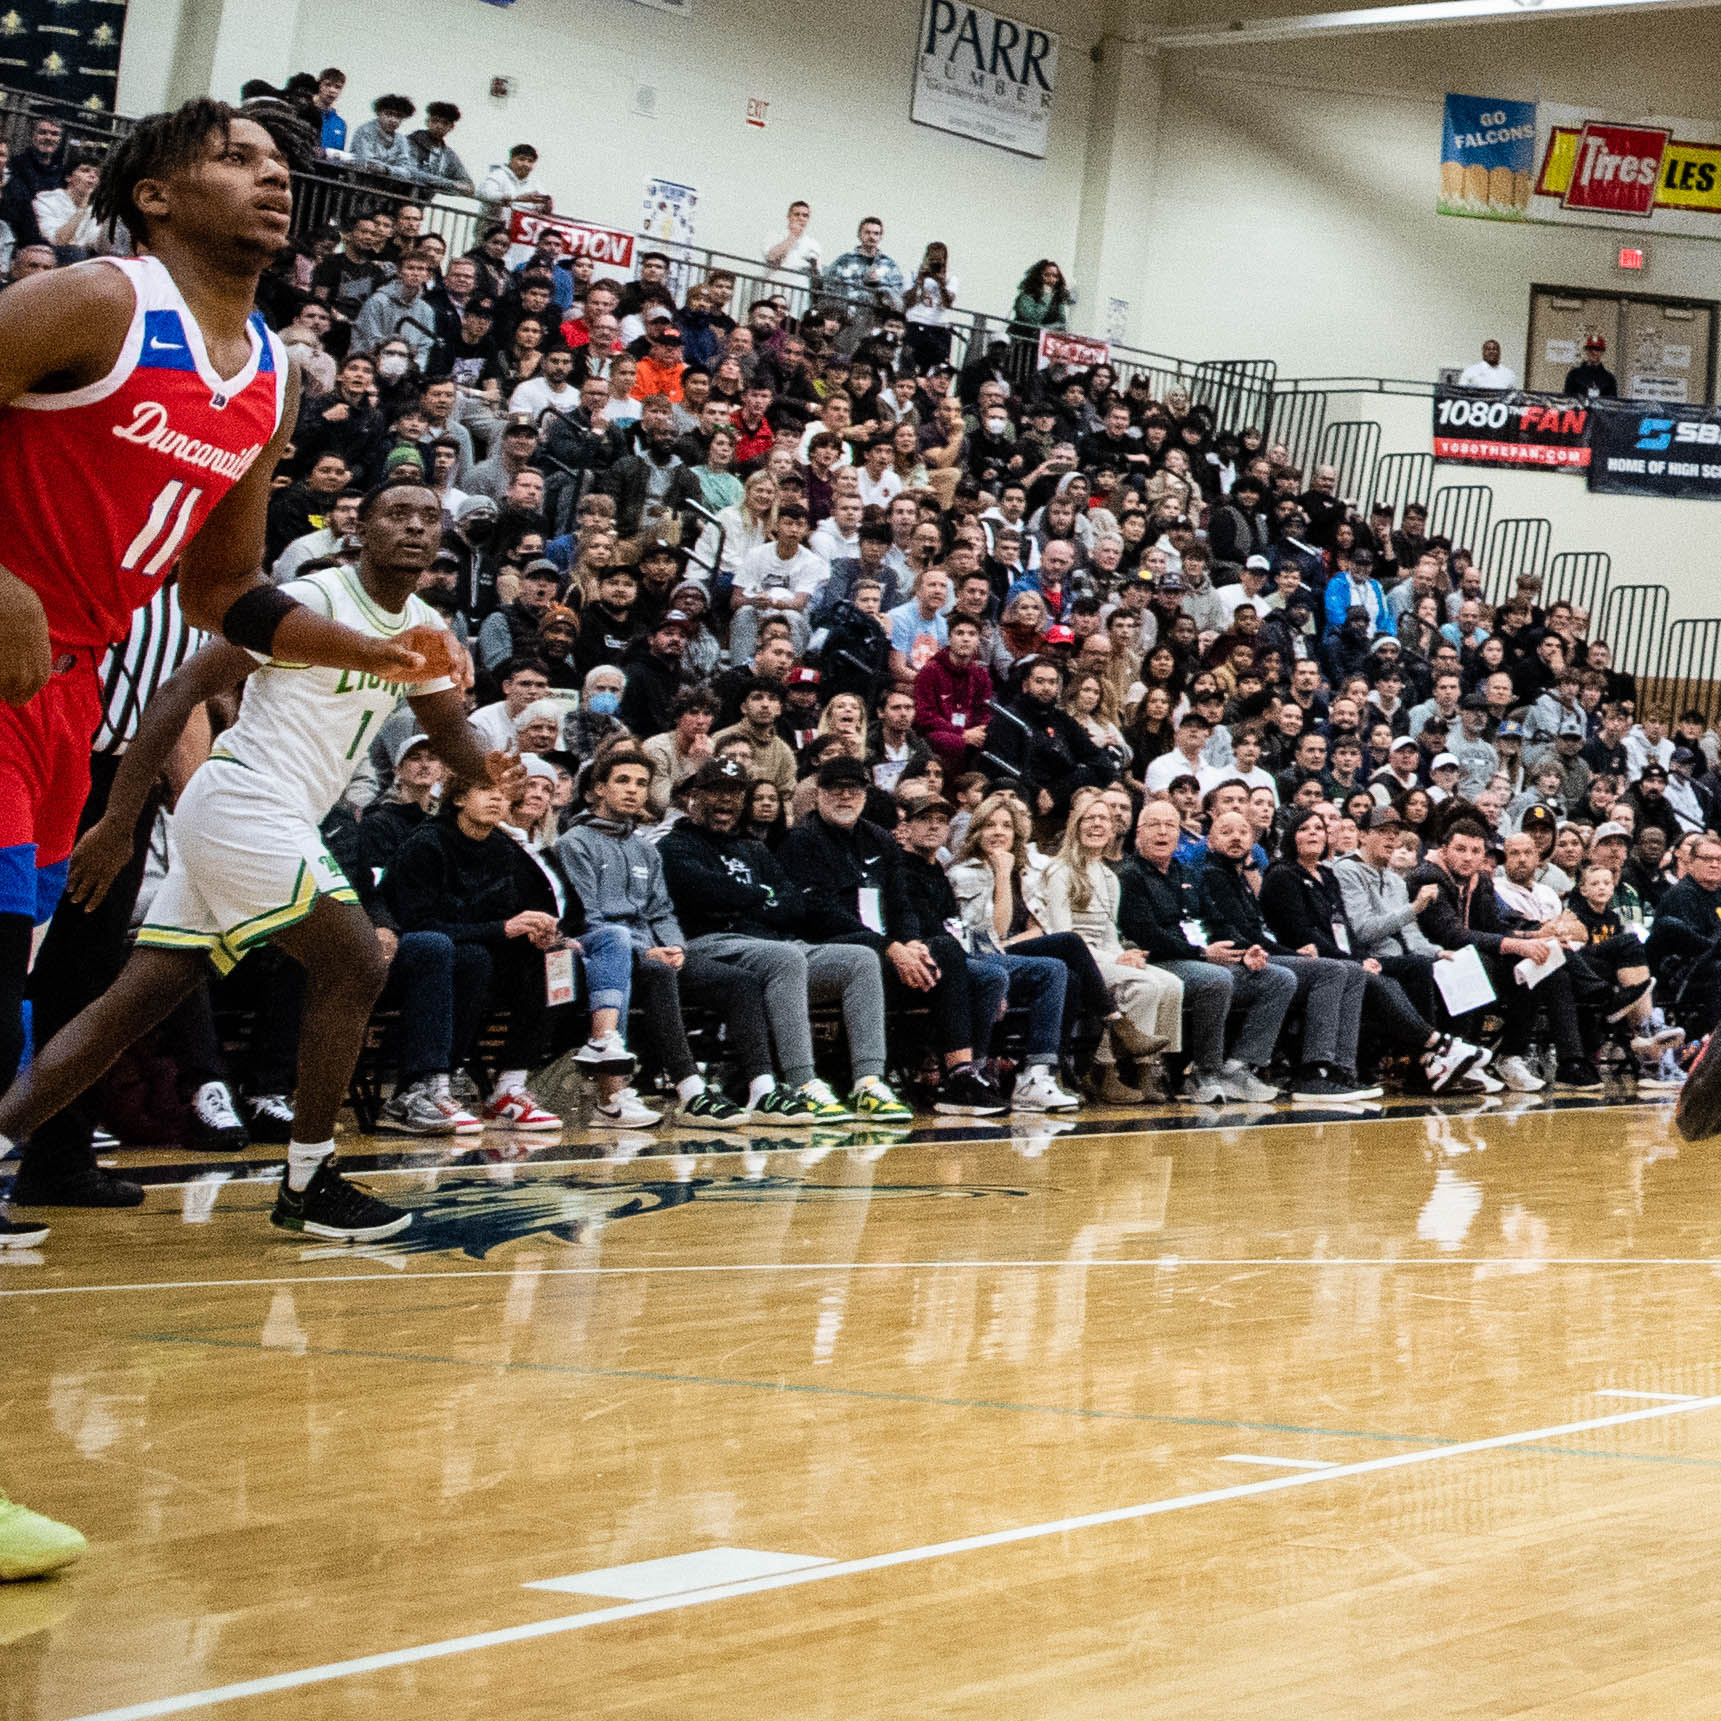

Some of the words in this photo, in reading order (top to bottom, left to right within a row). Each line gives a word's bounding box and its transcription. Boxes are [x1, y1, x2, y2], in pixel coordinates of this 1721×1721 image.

[1479, 110, 1508, 128] GO
[1454, 125, 1535, 150] FALCONS
[1581, 135, 1660, 187] Tires
[1664, 159, 1715, 192] LES
[1438, 399, 1508, 429] 1080
[1520, 405, 1587, 434] FAN
[1441, 442, 1581, 463] 1080THEFAN.COM
[1607, 457, 1646, 474] HOME
[1648, 459, 1665, 475] OF
[1668, 461, 1699, 477] HIGH
[121, 478, 203, 577] 11
[346, 710, 373, 760] 1
